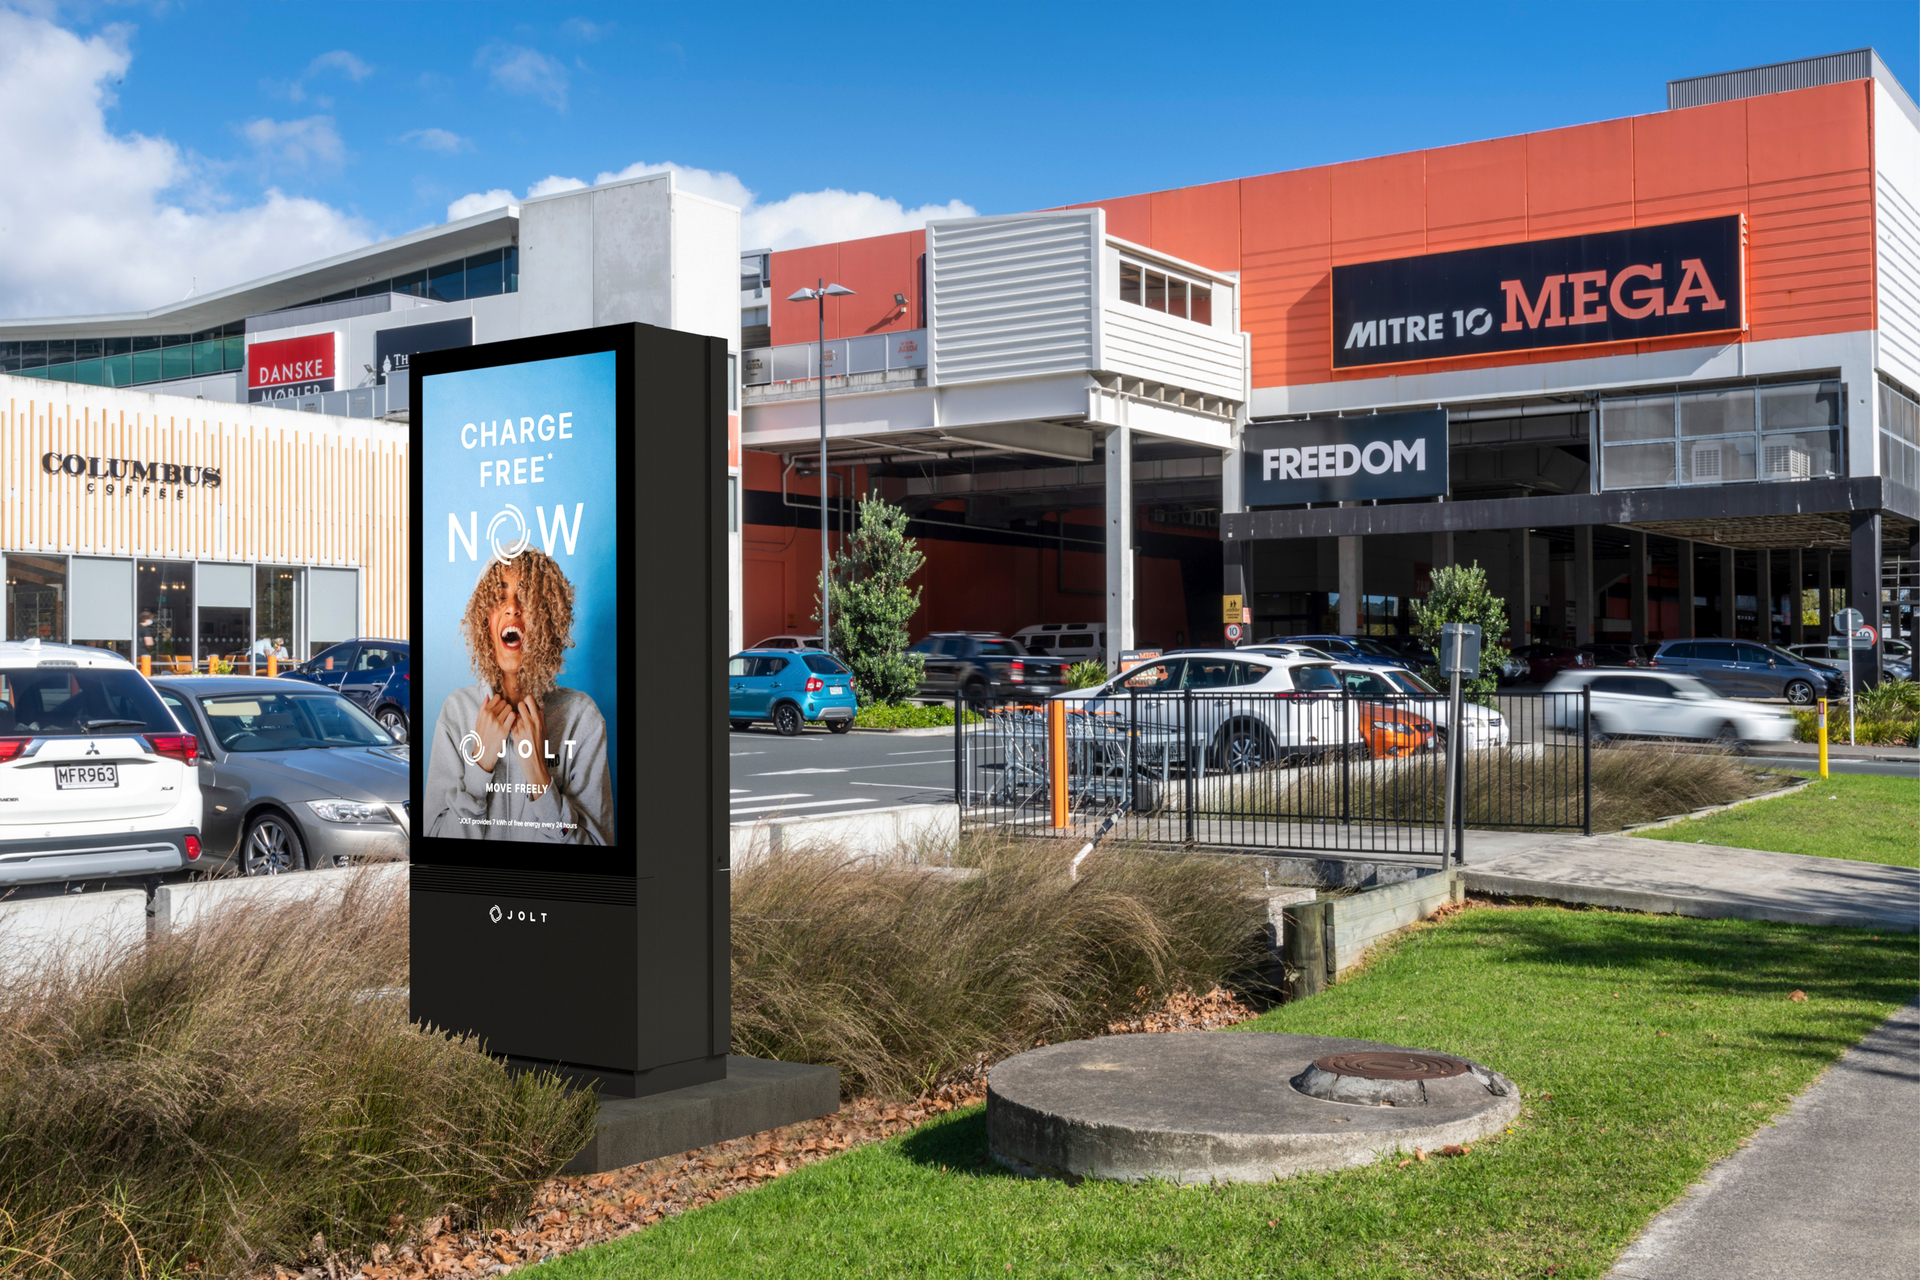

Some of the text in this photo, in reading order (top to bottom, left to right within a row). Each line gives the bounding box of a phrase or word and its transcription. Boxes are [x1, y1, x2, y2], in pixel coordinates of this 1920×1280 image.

[1344, 258, 1726, 350] MITRE 10 MEGA
[260, 359, 323, 384] DANSKE
[461, 411, 573, 450] CHARGE
[42, 451, 222, 488] COLUMBUS
[1262, 438, 1428, 482] FREEDOM
[87, 482, 184, 501] COFFEE
[448, 502, 585, 566] NOW
[1229, 627, 1238, 637] 10
[1139, 651, 1161, 659] MEGA
[497, 739, 576, 759] JOLT
[58, 767, 116, 783] MFR963
[485, 783, 548, 794] MOVE FREELY
[472, 818, 492, 826] provides
[497, 818, 507, 826] kWh
[514, 819, 523, 827] free
[524, 821, 541, 829] energy
[556, 821, 563, 829] 24
[507, 910, 547, 922] JOLT
